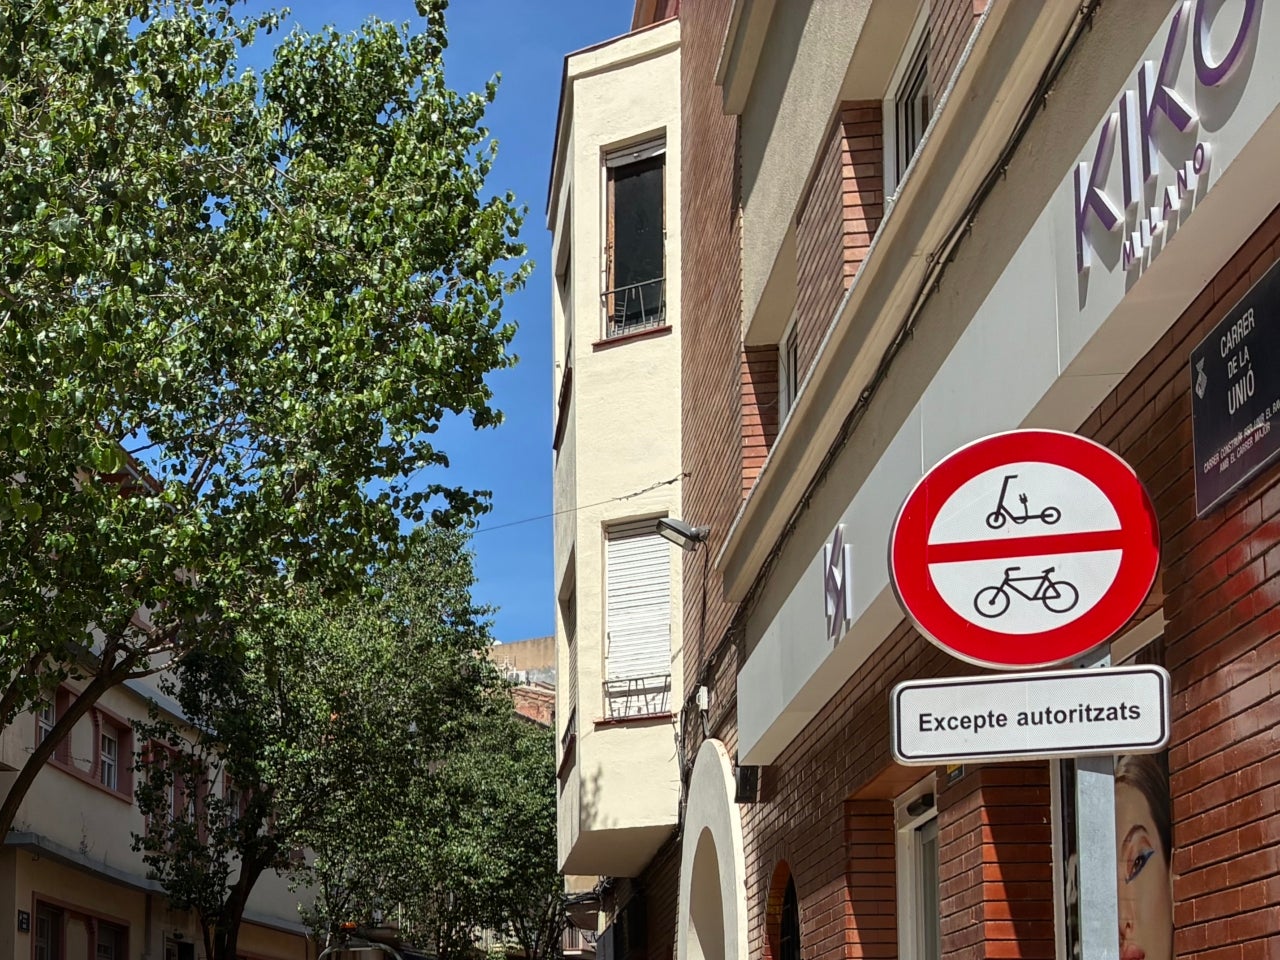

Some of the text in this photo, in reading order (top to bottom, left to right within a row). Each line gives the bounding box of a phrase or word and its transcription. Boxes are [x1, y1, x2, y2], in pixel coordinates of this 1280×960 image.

[1073, 0, 1265, 275] KIKO
[1122, 142, 1212, 271] MILANO
[1220, 308, 1255, 358] CARRER
[1227, 345, 1250, 379] DE LA
[1227, 363, 1255, 415] UNIÓ
[1203, 453, 1220, 474] CARRER
[1219, 421, 1270, 473] AMB EL CARRER MAJOR
[919, 702, 1141, 733] Excepte autoritzats
